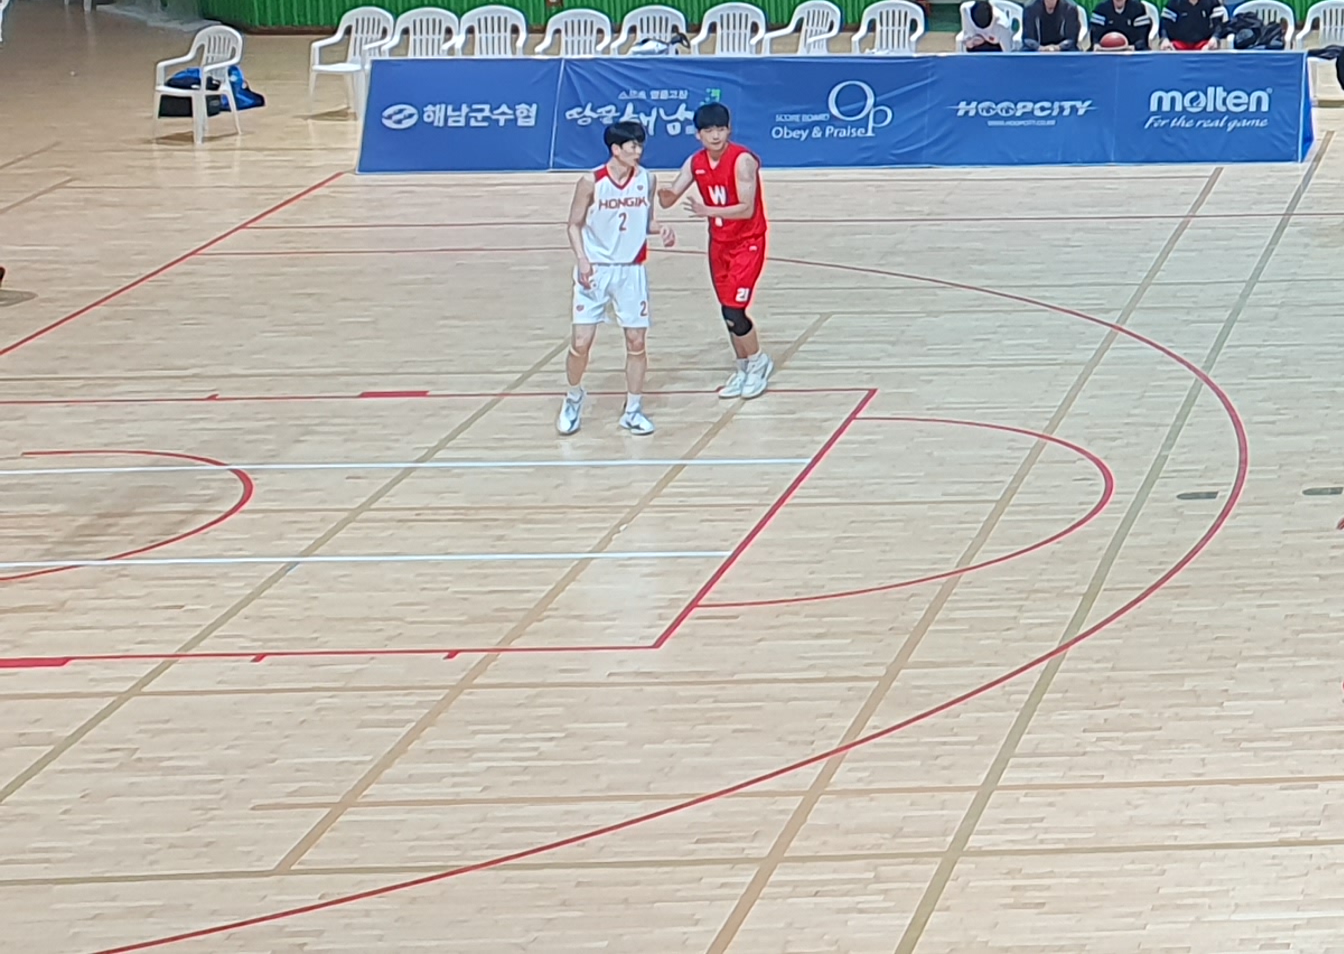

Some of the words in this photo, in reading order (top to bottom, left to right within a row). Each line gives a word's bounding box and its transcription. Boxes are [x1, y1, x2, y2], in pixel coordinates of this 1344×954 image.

[1149, 86, 1270, 113] molten
[422, 102, 538, 129] 해남군수협
[956, 100, 1093, 117] HOOPCITY
[1144, 115, 1170, 129] For
[1170, 115, 1194, 128] the
[1195, 115, 1229, 128] real
[1226, 118, 1269, 133] game
[771, 125, 809, 141] Obey
[811, 125, 823, 139] &
[825, 125, 867, 139] Praise
[599, 197, 648, 210] HONGIK
[618, 212, 628, 232] 2
[639, 300, 648, 317] 2
